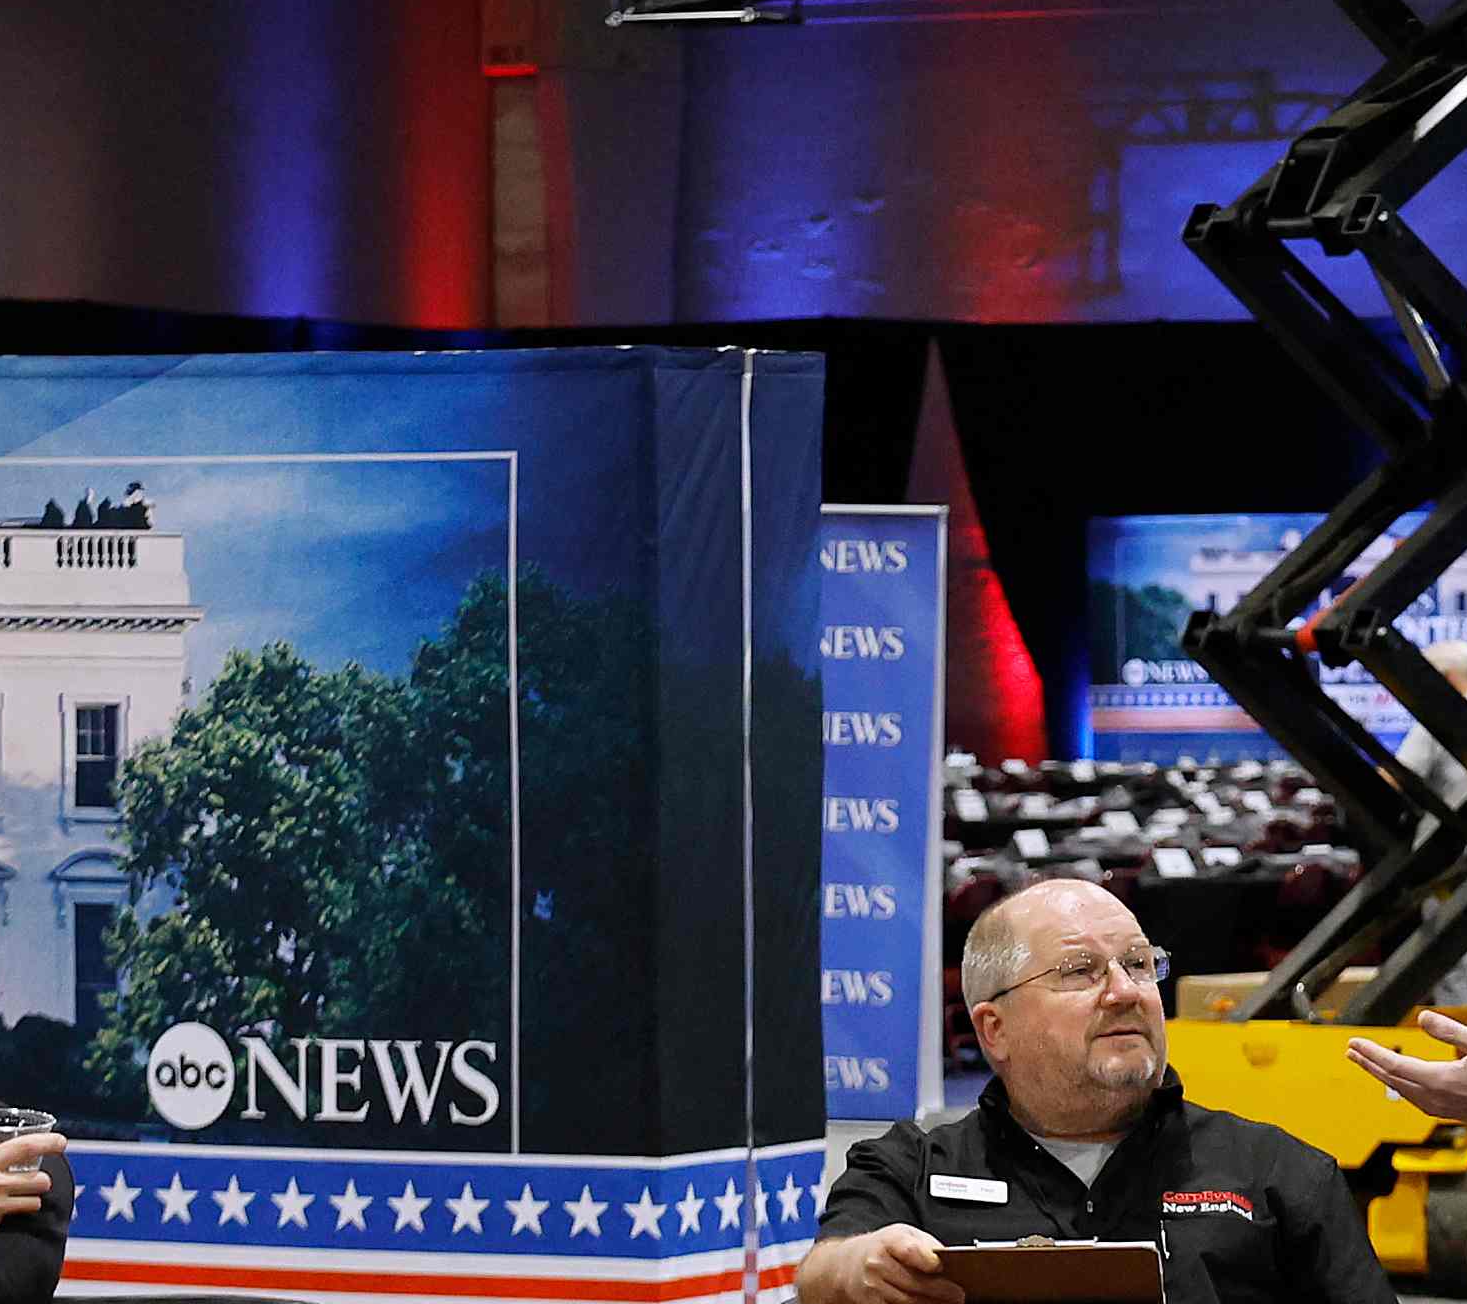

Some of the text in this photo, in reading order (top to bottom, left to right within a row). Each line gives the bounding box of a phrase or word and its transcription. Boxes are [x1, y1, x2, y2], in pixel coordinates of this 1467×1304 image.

[823, 712, 902, 747] EWS
[825, 798, 900, 834] EWS
[824, 884, 897, 920] EWS
[821, 969, 894, 1007] EWS
[154, 1036, 501, 1127] abc NEWS
[825, 1056, 890, 1092] EWS
[1162, 1199, 1253, 1222] New England
